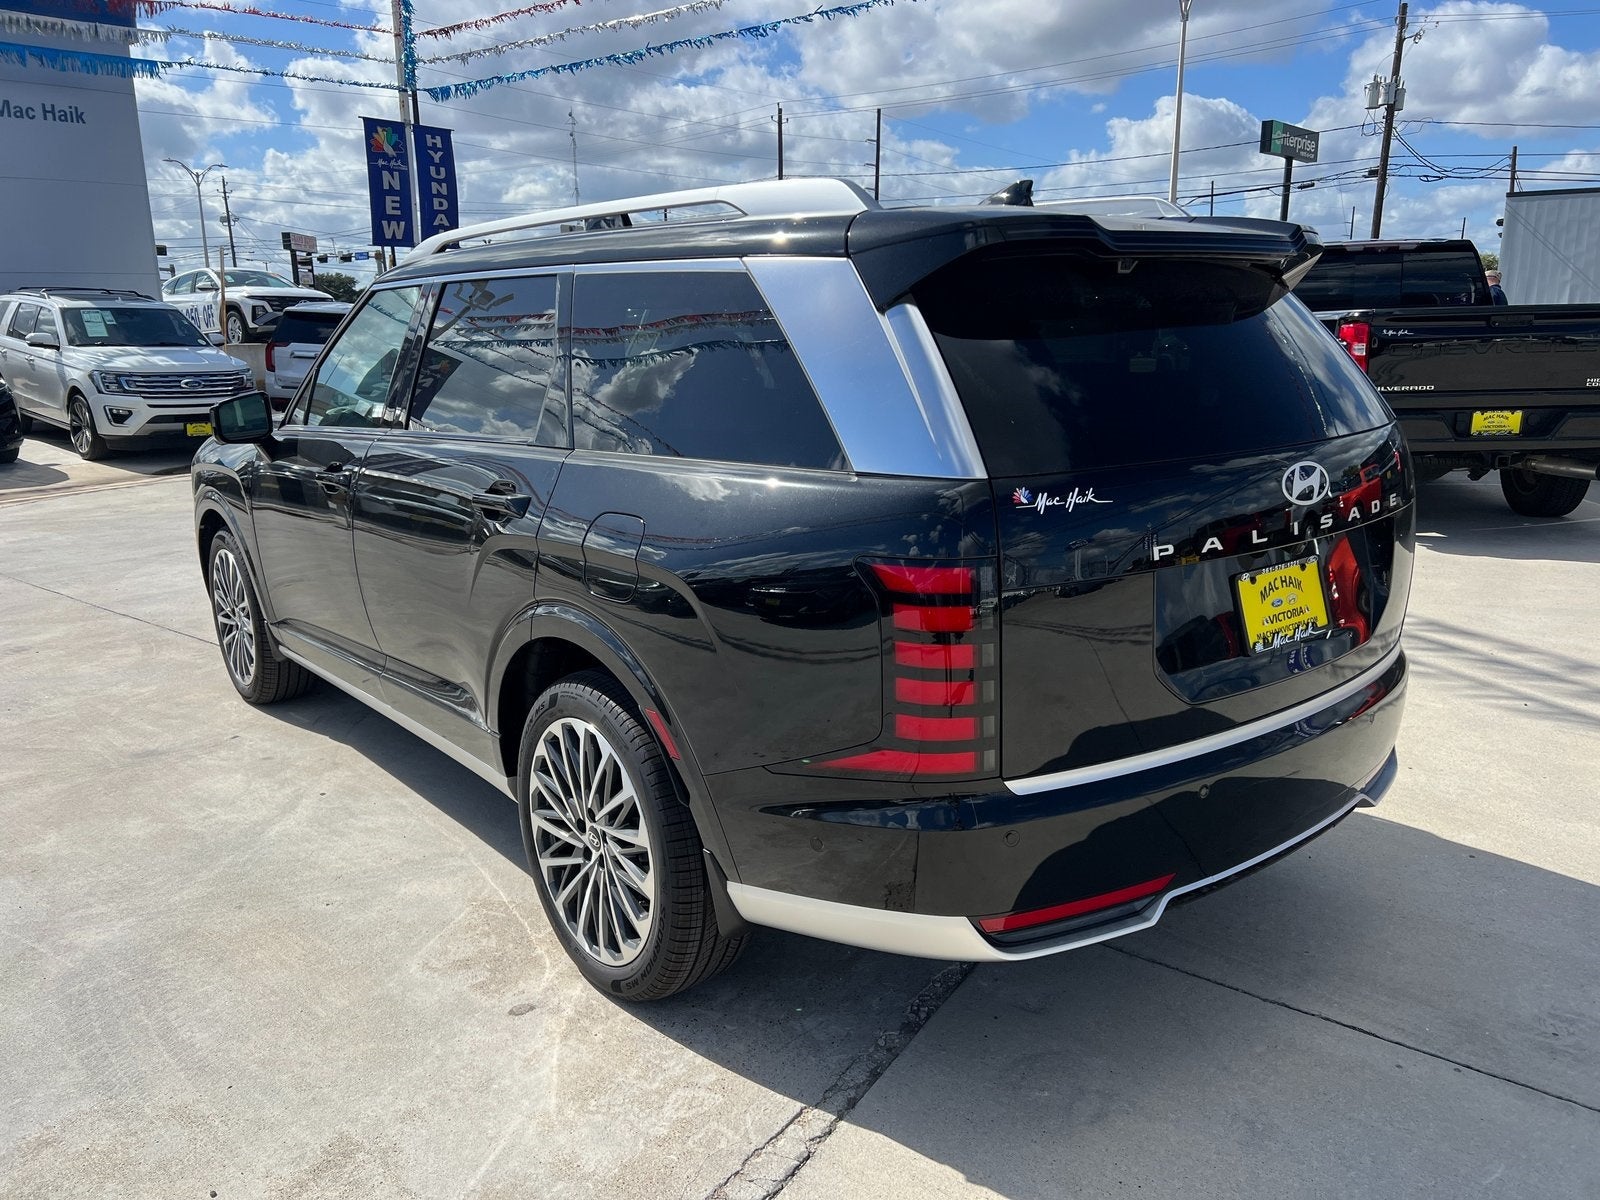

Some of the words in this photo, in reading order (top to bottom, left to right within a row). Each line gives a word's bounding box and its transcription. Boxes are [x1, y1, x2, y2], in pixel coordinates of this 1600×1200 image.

[41, 102, 87, 125] Haik
[1272, 130, 1316, 153] enterprise
[425, 134, 451, 234] HYUNDA
[381, 170, 406, 240] NEW
[202, 303, 216, 329] OFF
[1376, 385, 1435, 393] ILVERADO
[1026, 492, 1065, 515] Mac
[1065, 487, 1105, 513] Haik
[1152, 492, 1398, 562] PALISADE
[1259, 577, 1281, 604] MAC
[1279, 575, 1304, 593] HAIK
[1267, 605, 1306, 625] VICTORIA
[1268, 631, 1294, 649] Mac
[1294, 621, 1319, 642] Haik
